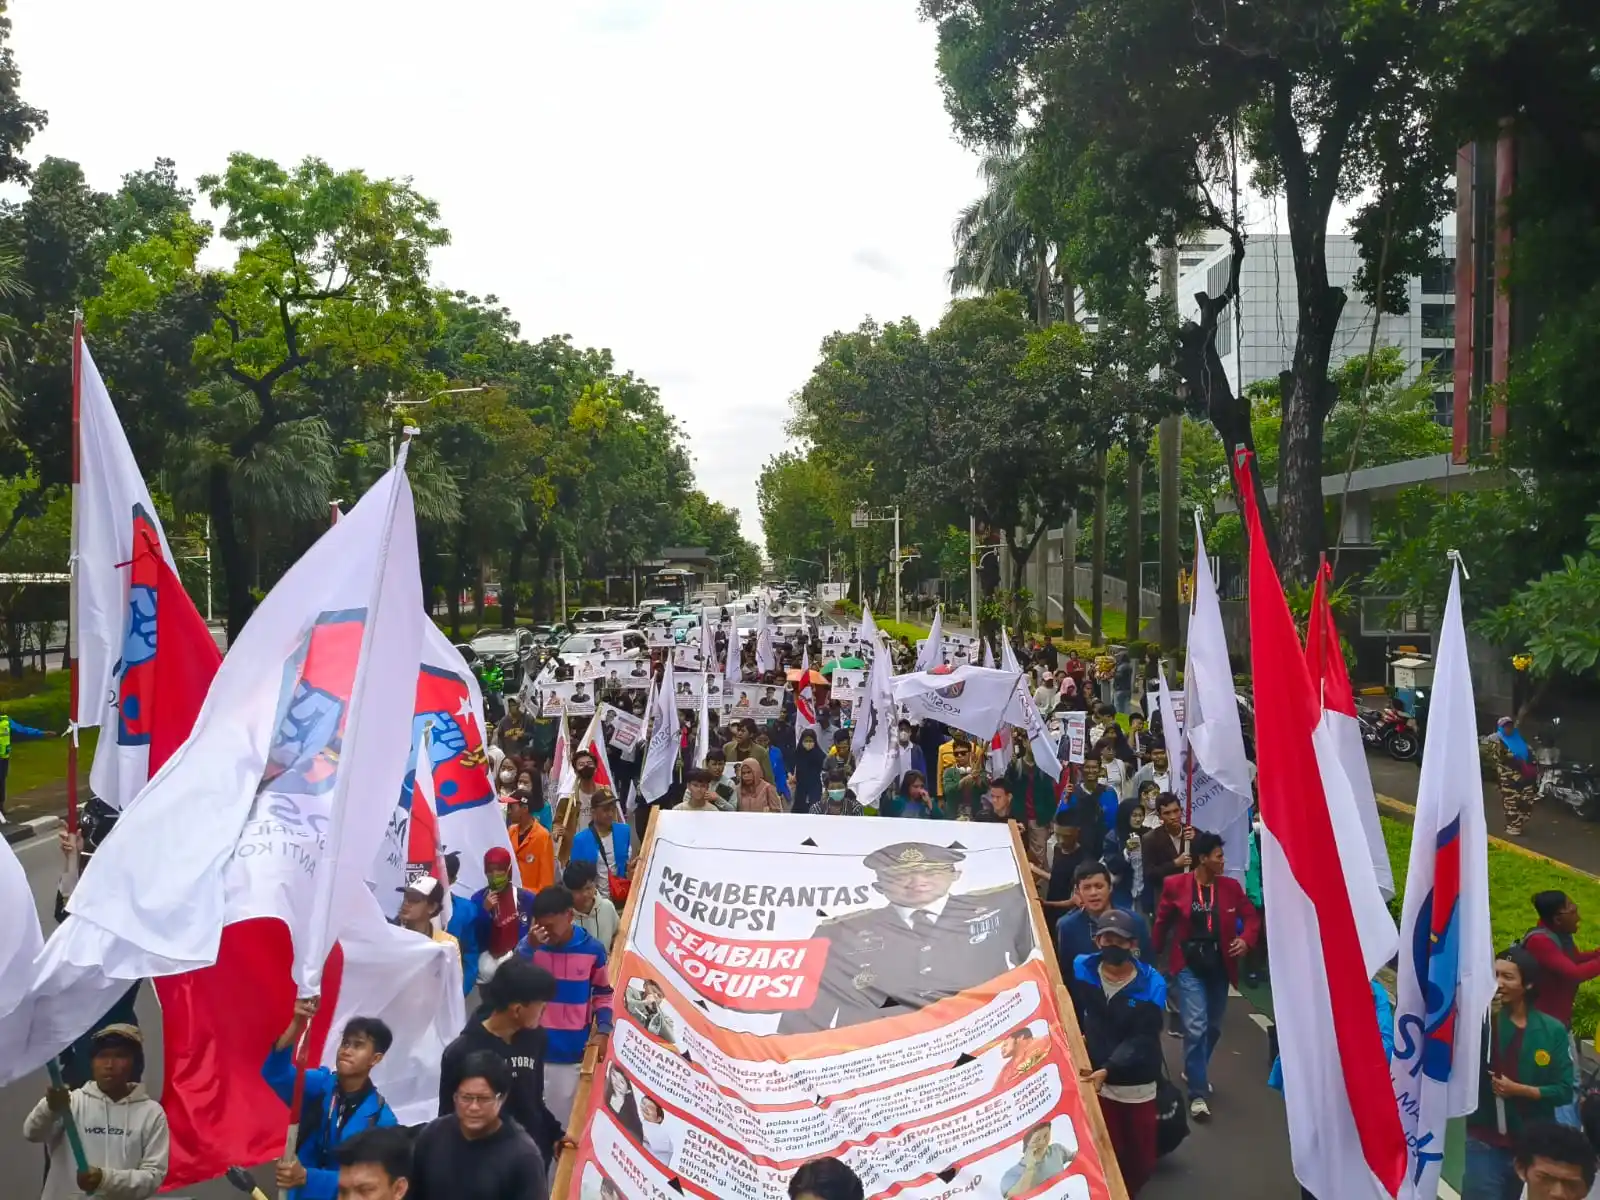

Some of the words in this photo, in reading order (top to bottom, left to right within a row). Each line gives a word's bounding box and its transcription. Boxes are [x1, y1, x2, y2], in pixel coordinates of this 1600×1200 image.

[658, 880, 776, 932] KORUPSI
[662, 865, 869, 908] MEMBERANTAS
[664, 940, 805, 999] KORUPSI
[665, 919, 808, 971] SEMBARI
[511, 1056, 535, 1070] YORK
[620, 1049, 648, 1077] Diduga
[648, 1075, 693, 1105] dilindungi
[627, 1028, 692, 1077] SUGIANTO
[766, 1118, 799, 1128] pelaku
[905, 1081, 936, 1094] Kaltim
[821, 1056, 873, 1073] Narapidana
[679, 1157, 727, 1187] dilindungi
[925, 1144, 958, 1165] diduga
[962, 1119, 1012, 1146] mendapat
[1016, 1093, 1052, 1122] imbalan
[681, 1147, 719, 1173] RICAR,
[725, 1170, 757, 1194] hingga
[1018, 1086, 1050, 1111] Diduga
[683, 1138, 728, 1167] PELAKU
[761, 1181, 781, 1193] Rp.
[975, 1104, 1012, 1125] markus
[686, 1129, 758, 1176] GUNAWAN
[886, 1115, 968, 1149] PURWANTI
[793, 1120, 825, 1132] negara
[678, 1165, 709, 1188] SUAP.
